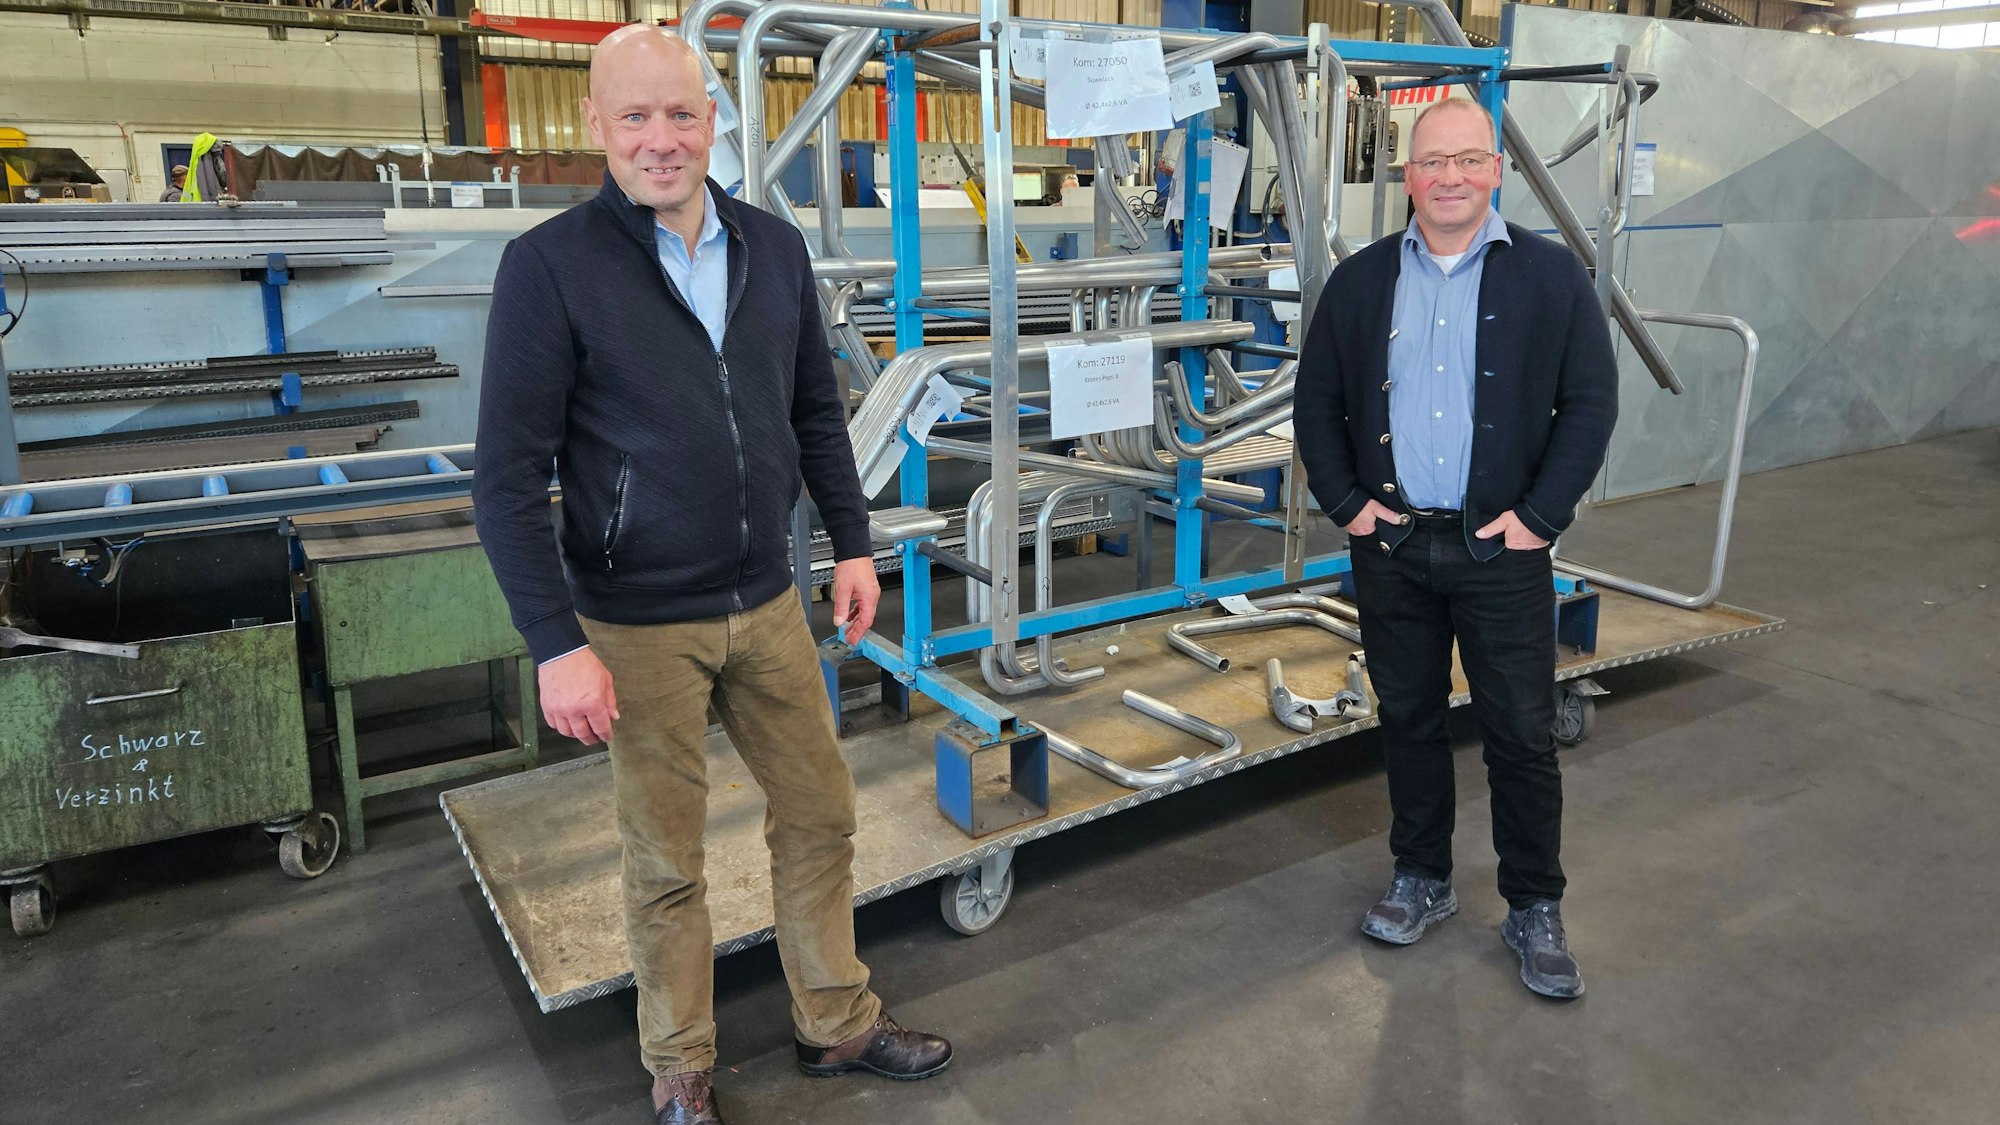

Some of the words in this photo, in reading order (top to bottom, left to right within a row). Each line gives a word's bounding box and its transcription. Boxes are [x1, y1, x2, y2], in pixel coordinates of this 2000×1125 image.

[1073, 57, 1095, 68] Kom:
[1097, 56, 1128, 68] 27050
[1077, 359, 1099, 369] Kom:
[1101, 355, 1126, 367] 27119
[81, 730, 205, 761] Schwarz
[55, 774, 174, 810] Verzinkt
